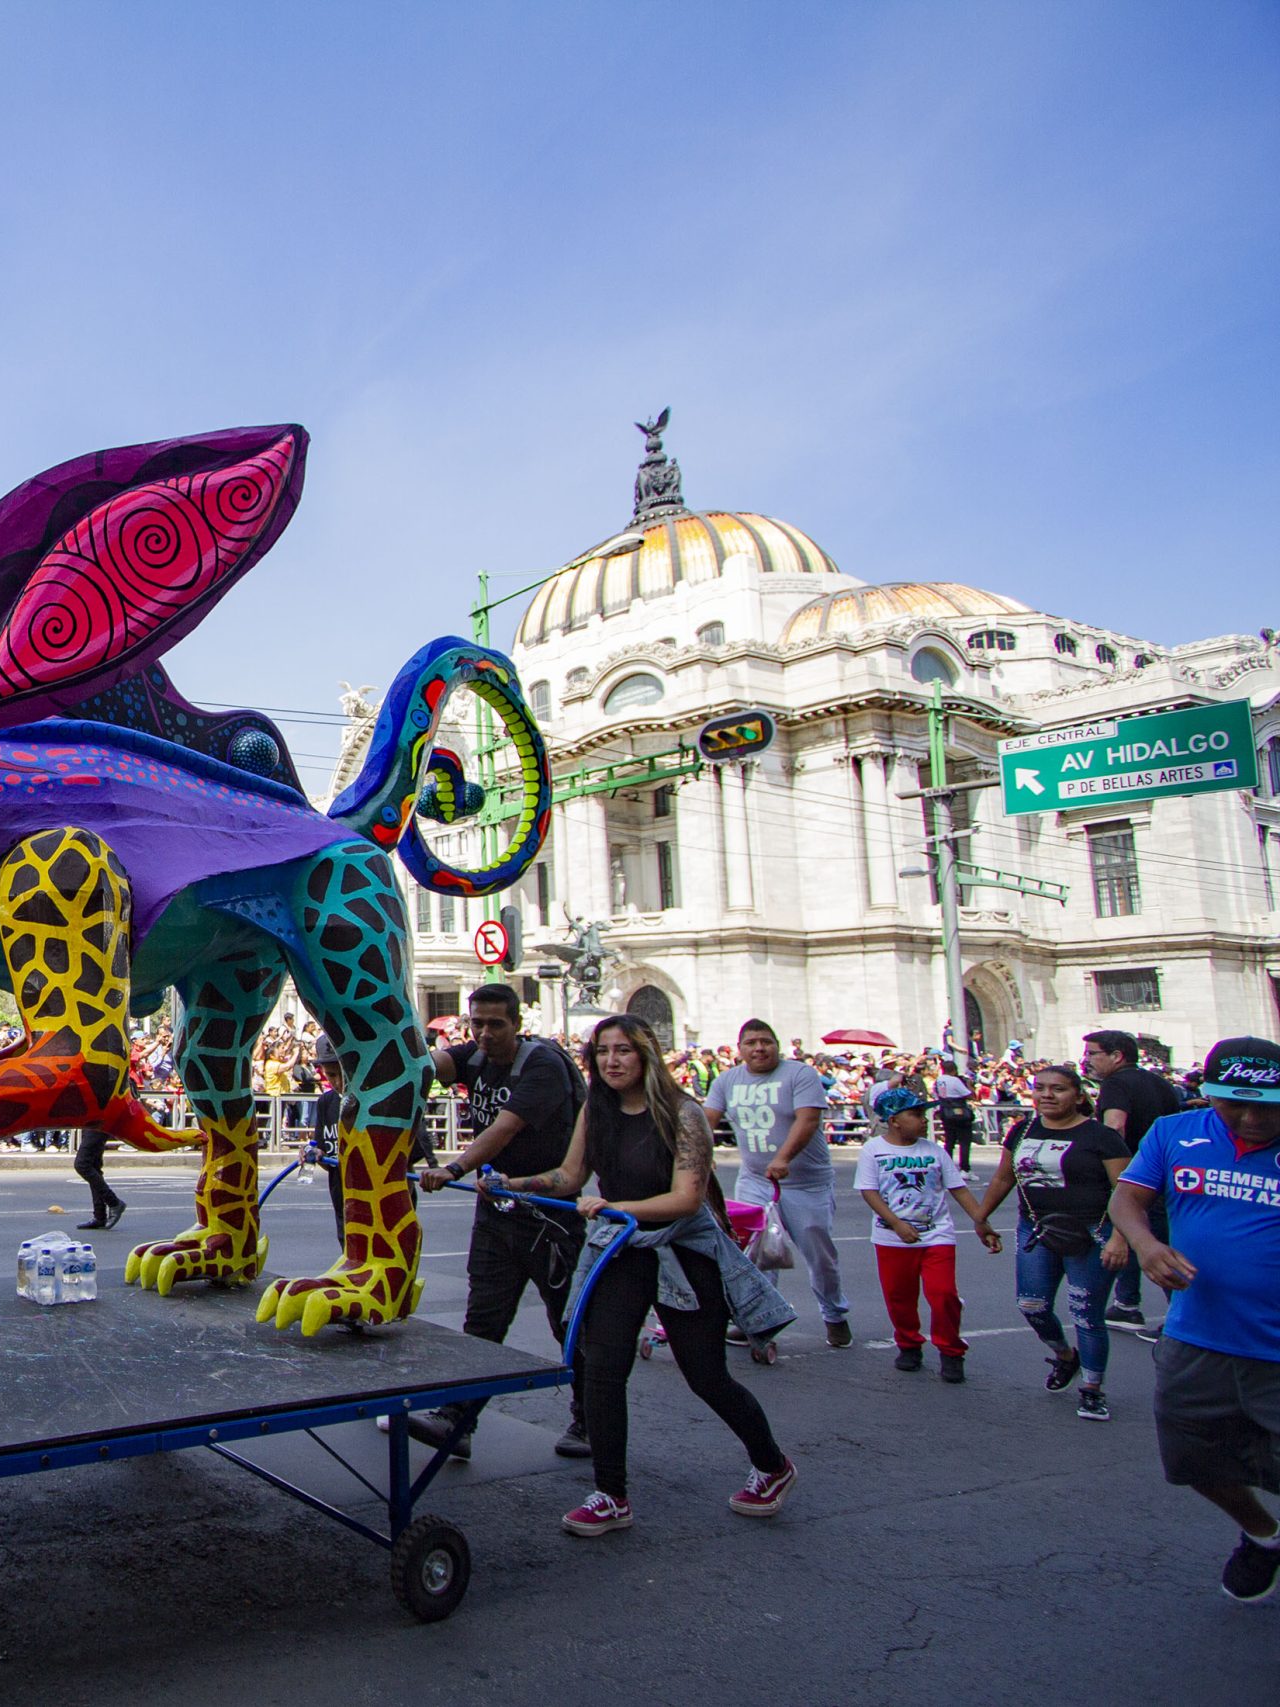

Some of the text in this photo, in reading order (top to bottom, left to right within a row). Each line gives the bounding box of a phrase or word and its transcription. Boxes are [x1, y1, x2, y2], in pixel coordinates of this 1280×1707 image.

[1005, 725, 1107, 750] EJE CENTRAL
[1060, 731, 1229, 773] AV HIDALGO
[1067, 766, 1204, 795] P DE BELLAS ARTES
[728, 1081, 782, 1108] JUST
[737, 1105, 776, 1130] DO
[746, 1128, 777, 1153] IT.
[885, 1155, 936, 1171] JUMP
[1204, 1182, 1254, 1202] CRUZ
[1205, 1168, 1280, 1191] CEMEN
